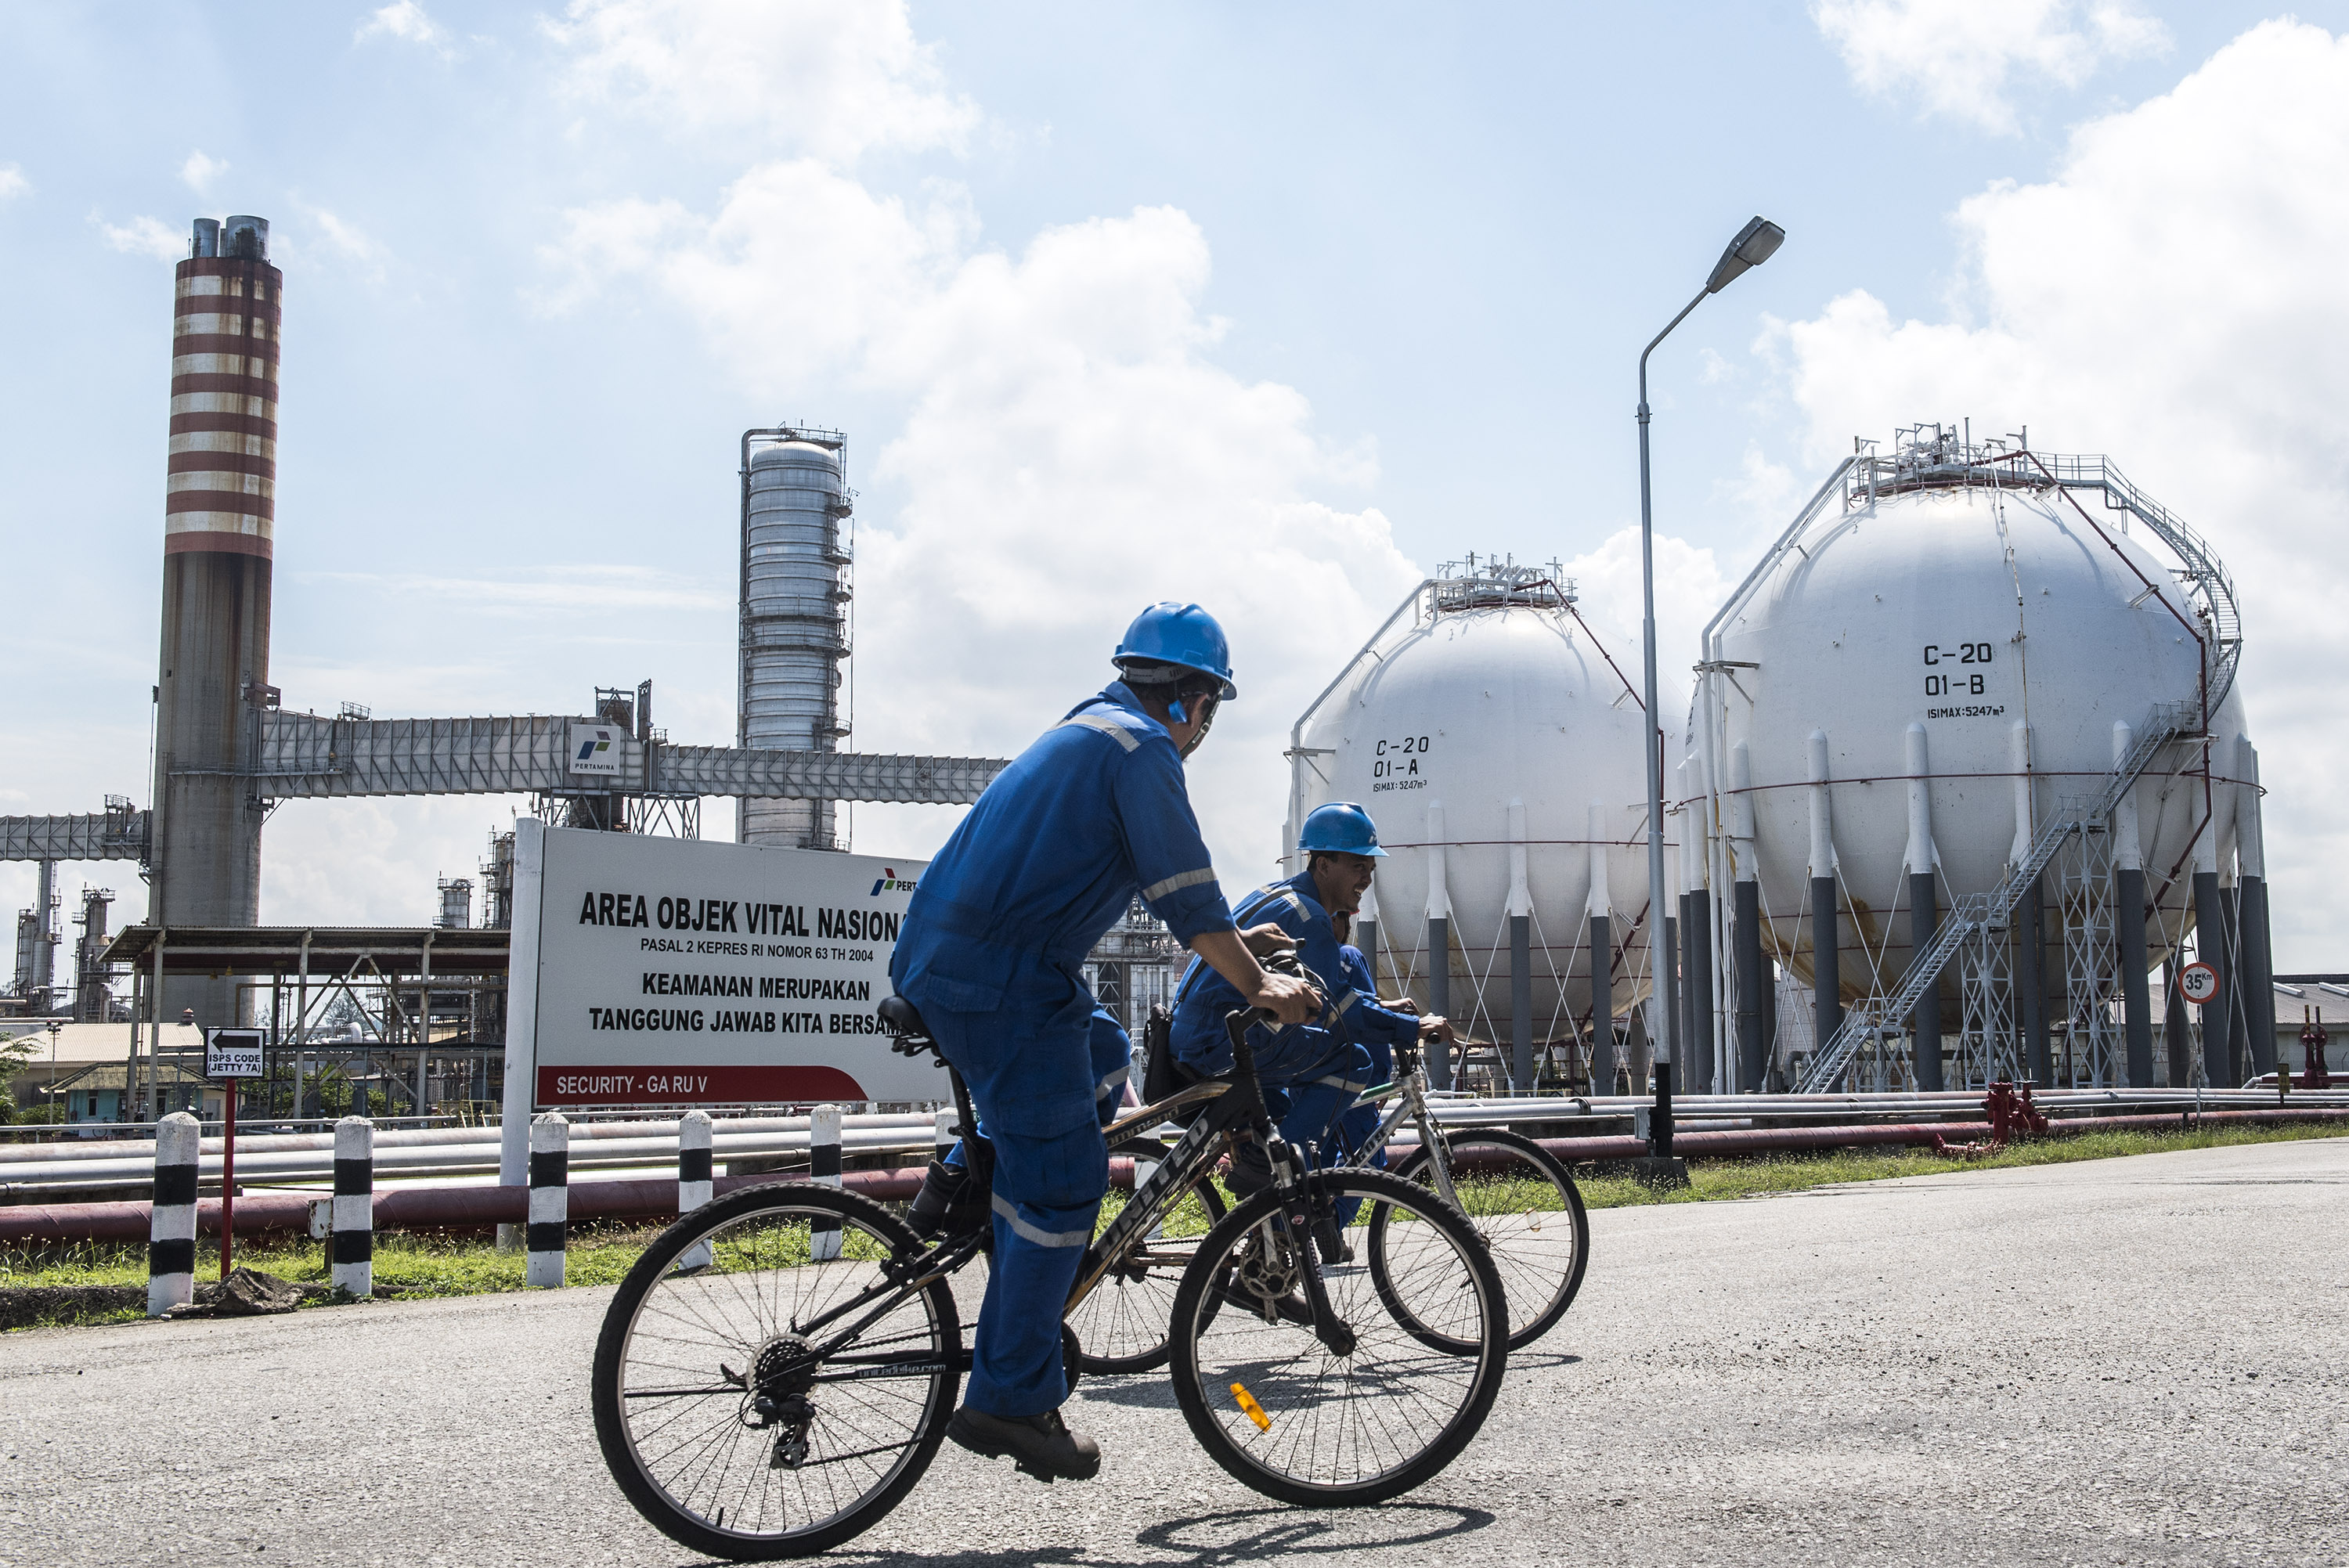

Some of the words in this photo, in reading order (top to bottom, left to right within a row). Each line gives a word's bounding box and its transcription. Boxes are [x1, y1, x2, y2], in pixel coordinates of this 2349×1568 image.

[1924, 643, 1992, 665] C-20
[1925, 674, 1985, 696] 01-B
[1377, 736, 1429, 755] C-20
[1373, 759, 1418, 777] 01-A
[897, 881, 917, 892] PERT
[579, 892, 649, 928] AREA
[657, 896, 738, 932] OBJEK
[745, 903, 810, 938] VITAL
[817, 907, 907, 943] NASION
[640, 938, 684, 953] PASAL
[686, 939, 694, 953] 2
[697, 940, 749, 956] KEPRES
[751, 943, 763, 957] RI
[767, 944, 813, 959] NOMOR
[815, 946, 828, 960] 63
[832, 947, 846, 961] TH
[848, 949, 874, 962] 2004
[642, 972, 753, 998] KEAMANAN
[759, 977, 870, 1001] MERUPAKAN
[589, 1007, 704, 1032] TANGGUNG
[709, 1011, 776, 1033] JAWAB
[781, 1012, 824, 1033] KITA
[208, 1063, 243, 1073] (JETTY
[246, 1063, 261, 1073] 7A)
[209, 1054, 231, 1062] ISPS
[234, 1054, 261, 1062] CODE
[557, 1076, 634, 1094] SECURITY
[647, 1076, 669, 1093] GA
[673, 1076, 693, 1093] RU
[698, 1076, 708, 1093] V
[1096, 1117, 1209, 1260] UNITED
[859, 1364, 947, 1378] unitedbike.com
